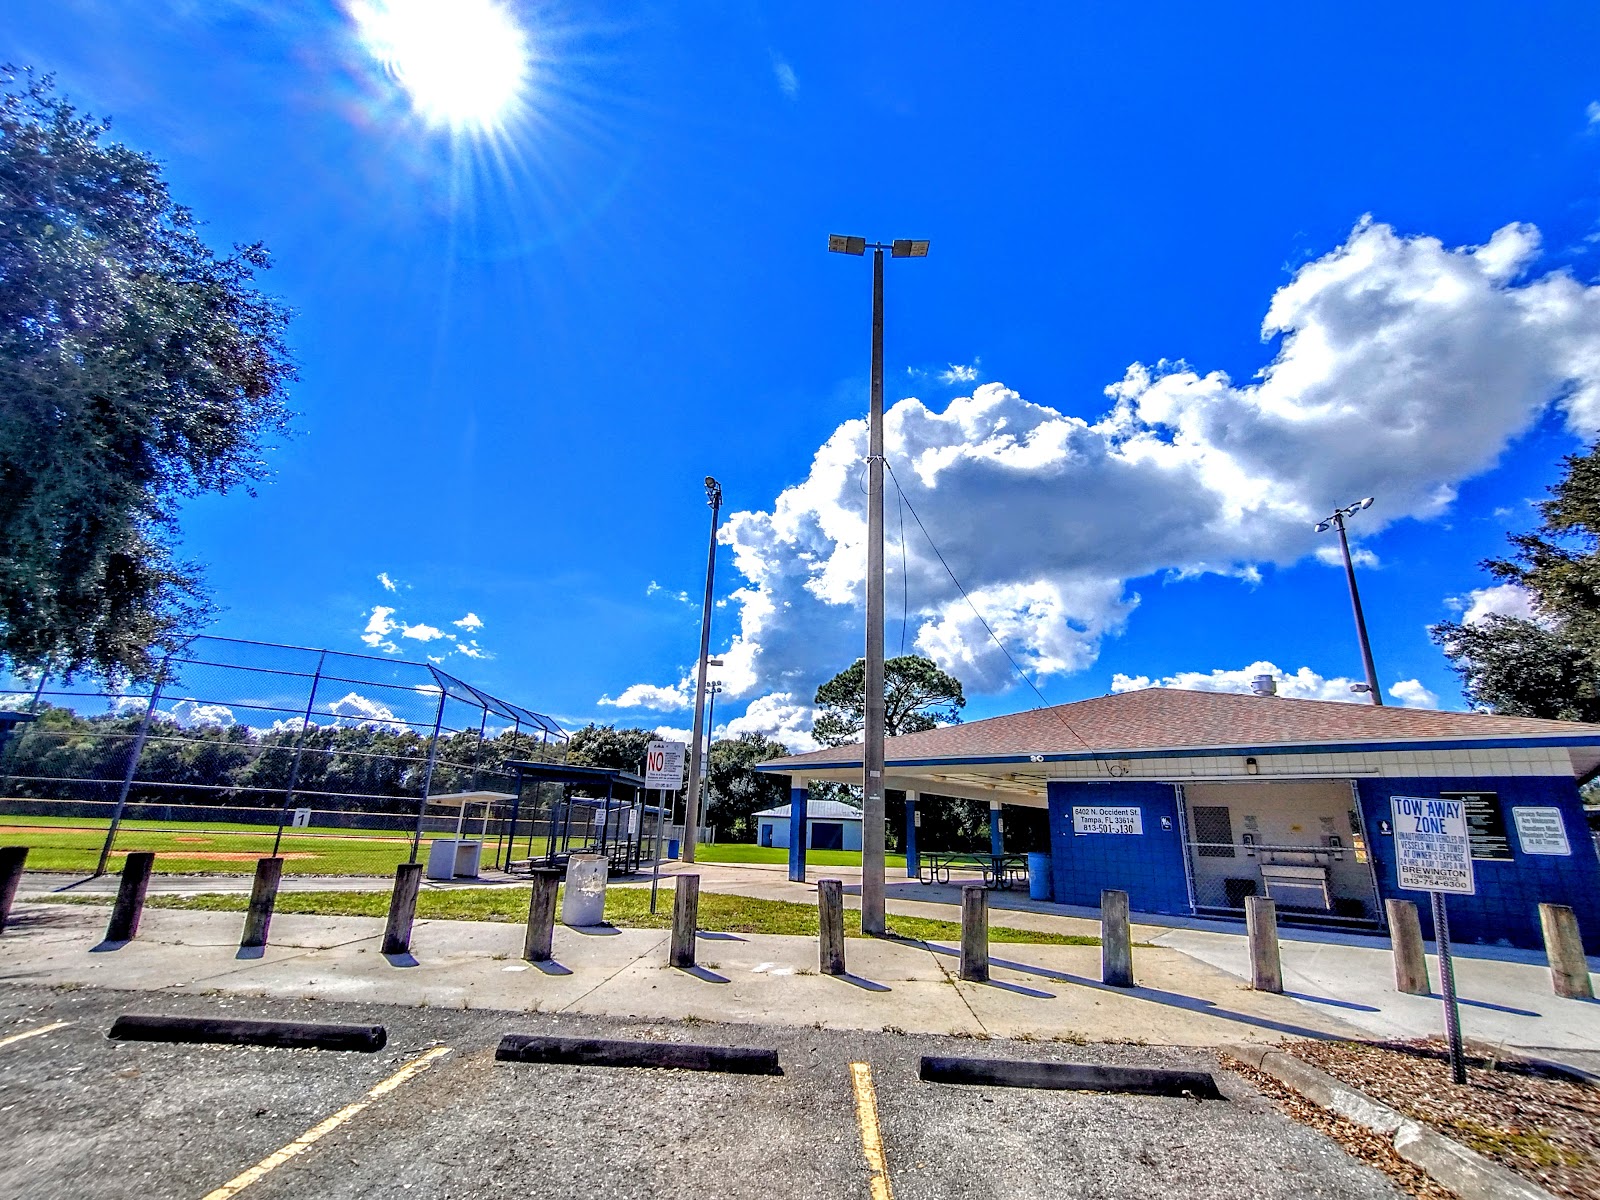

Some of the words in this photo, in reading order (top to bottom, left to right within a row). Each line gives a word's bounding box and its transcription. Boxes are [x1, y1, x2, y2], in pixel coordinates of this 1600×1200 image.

[648, 752, 664, 772] NO
[1394, 799, 1422, 816] TOW
[298, 814, 304, 826] 1
[1414, 816, 1447, 834] ZONE
[1401, 841, 1424, 850] VESSELS
[1425, 842, 1438, 851] WILL
[1439, 844, 1446, 852] BE
[1447, 844, 1464, 853] TOWED
[1412, 850, 1438, 860] OWNER'S
[1439, 852, 1464, 862] EXPENSE
[1402, 866, 1466, 878] BREWINGTON
[1403, 878, 1467, 888] 813-754-6300
